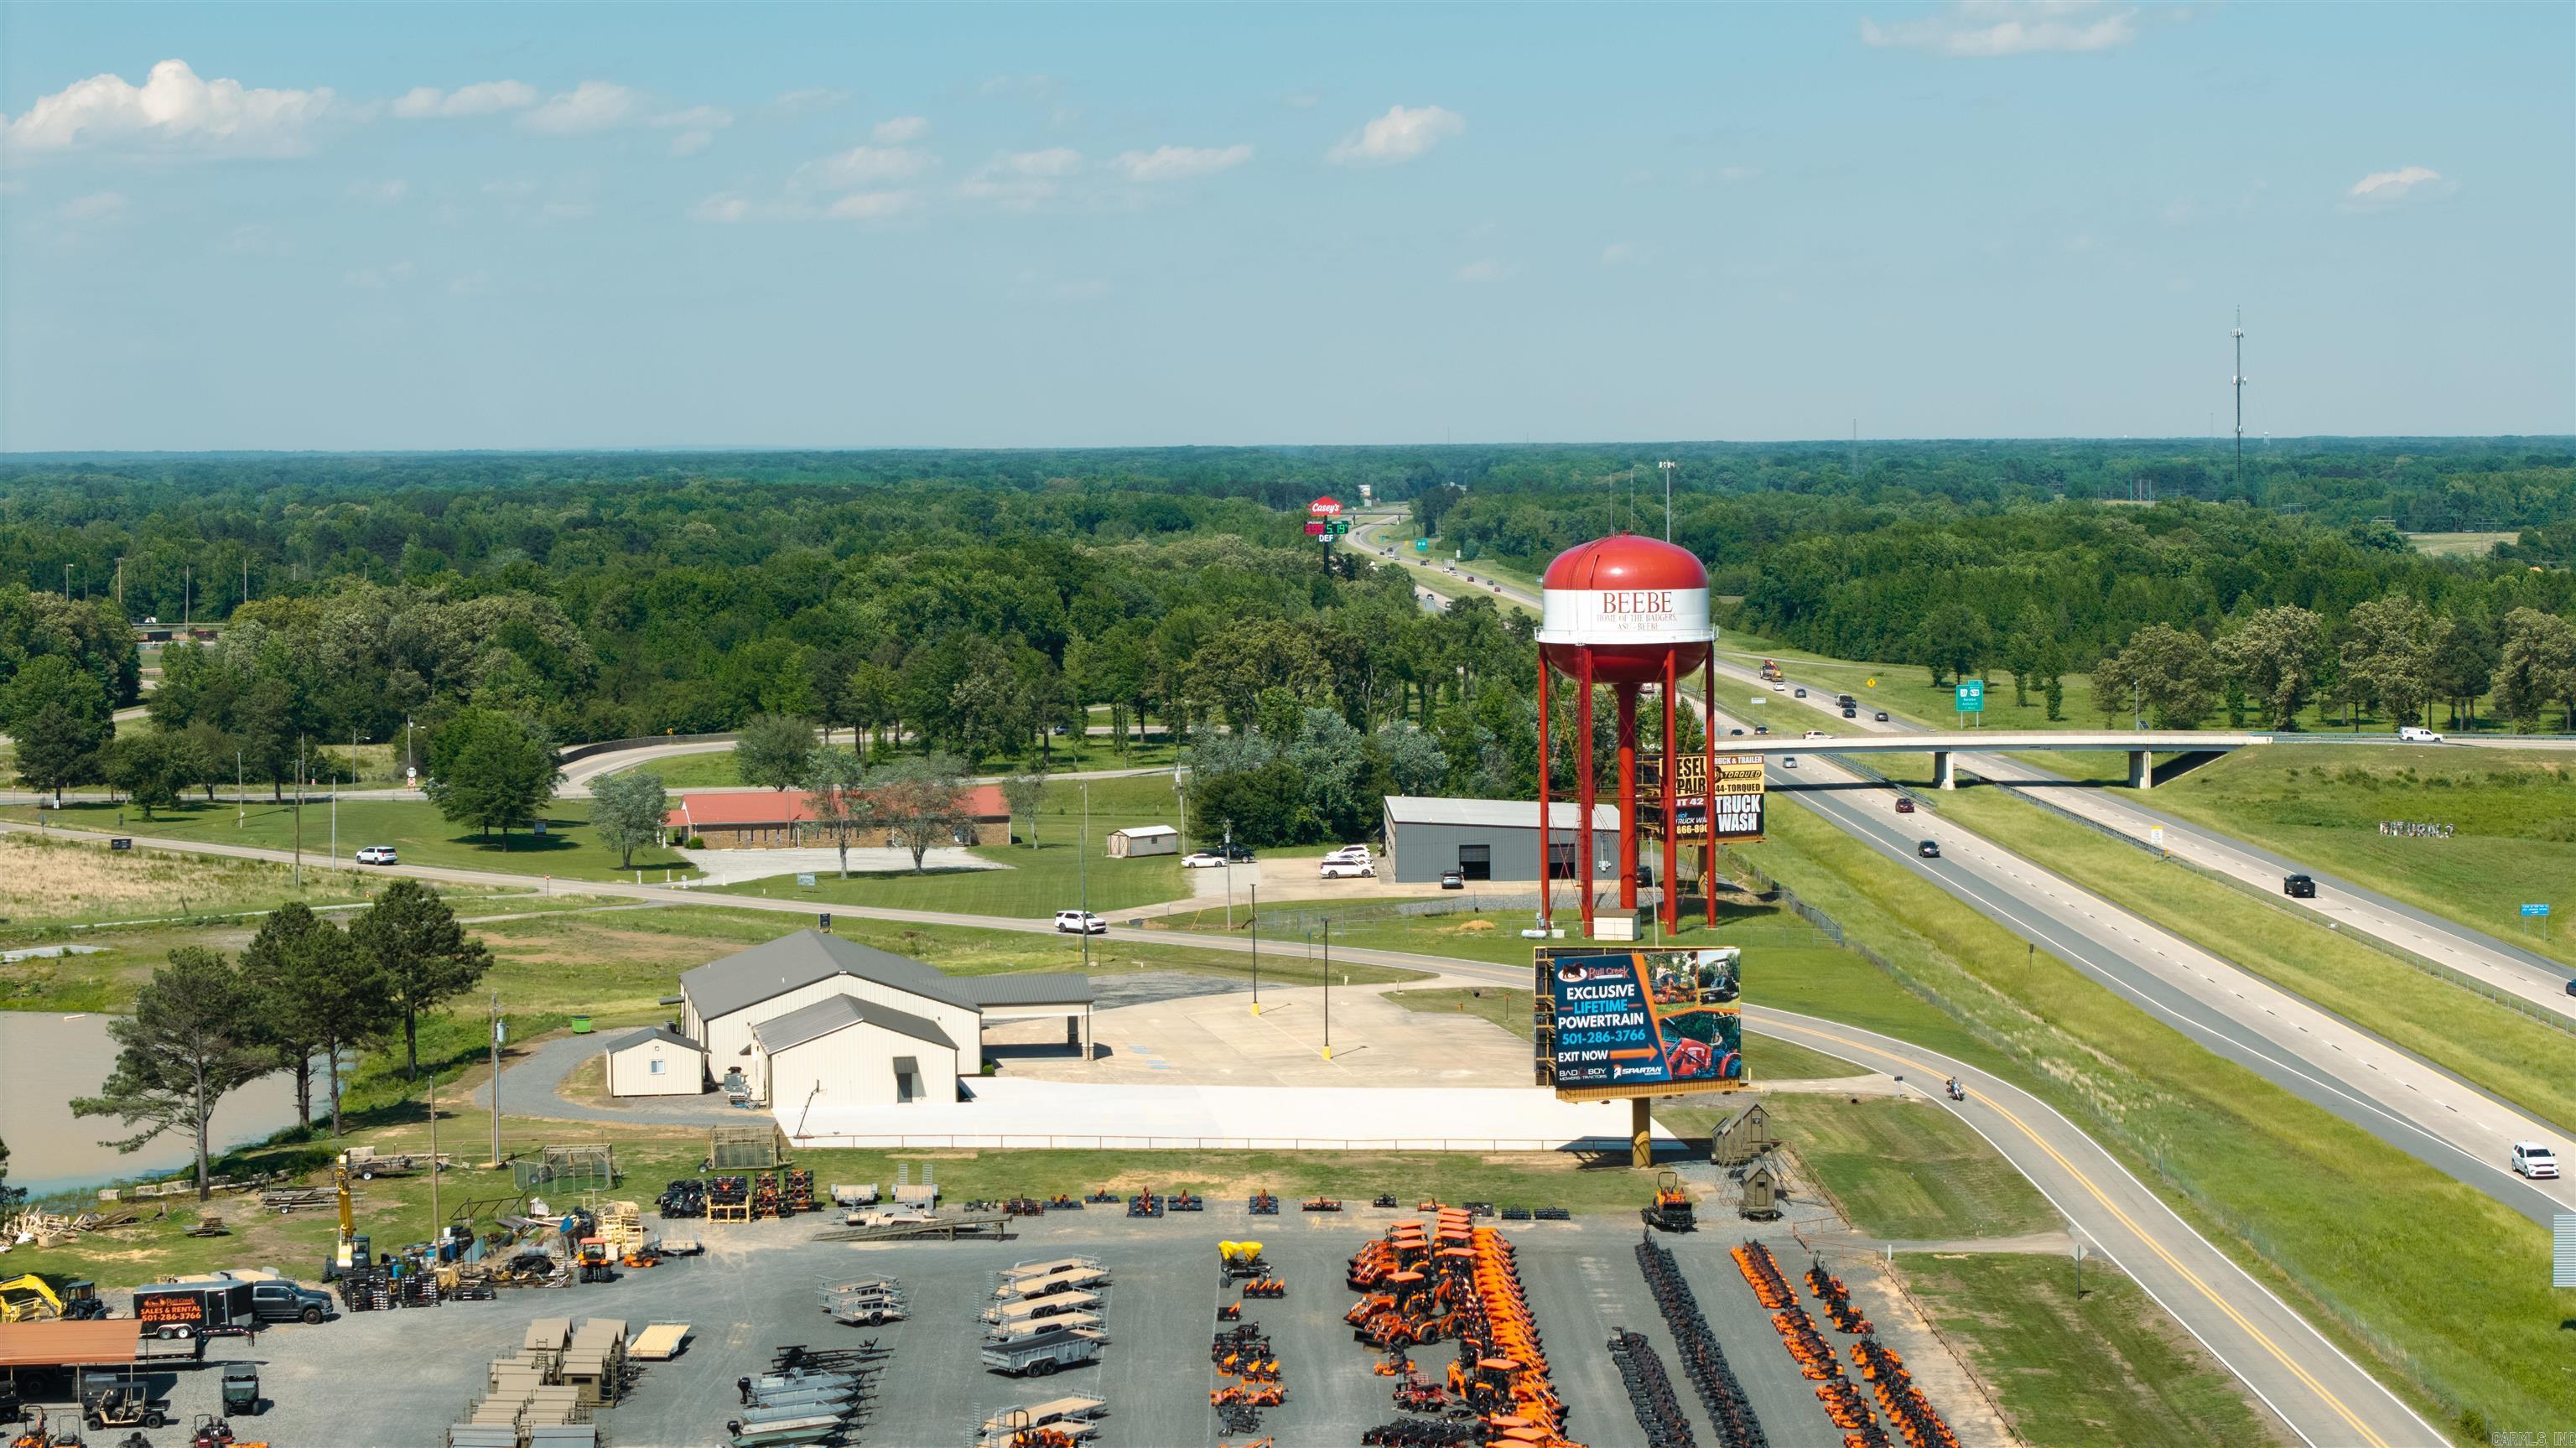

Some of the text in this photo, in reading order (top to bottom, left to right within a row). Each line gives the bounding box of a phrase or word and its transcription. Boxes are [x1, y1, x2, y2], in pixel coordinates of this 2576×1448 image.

[1312, 503, 1340, 513] Casey's
[1603, 591, 1673, 613] BEEBE
[1677, 758, 1706, 777] ESEL
[1677, 777, 1706, 794] PAIR
[1715, 784, 1761, 792] 44-TORQUED
[1715, 795, 1761, 813] TRUCK
[1718, 813, 1757, 832] WASH
[1588, 965, 1630, 980] Bull Creek
[1567, 984, 1635, 1000] EXCLUSIVE
[1574, 999, 1628, 1014] LIFETIME
[1558, 1013, 1644, 1029] POWERTRAIN
[1562, 1029, 1645, 1045] 501-286-3766
[1558, 1050, 1608, 1062] EXIT NOW
[1622, 1066, 1662, 1074] SPARTAN
[142, 1312, 201, 1321] 501-286-3766
